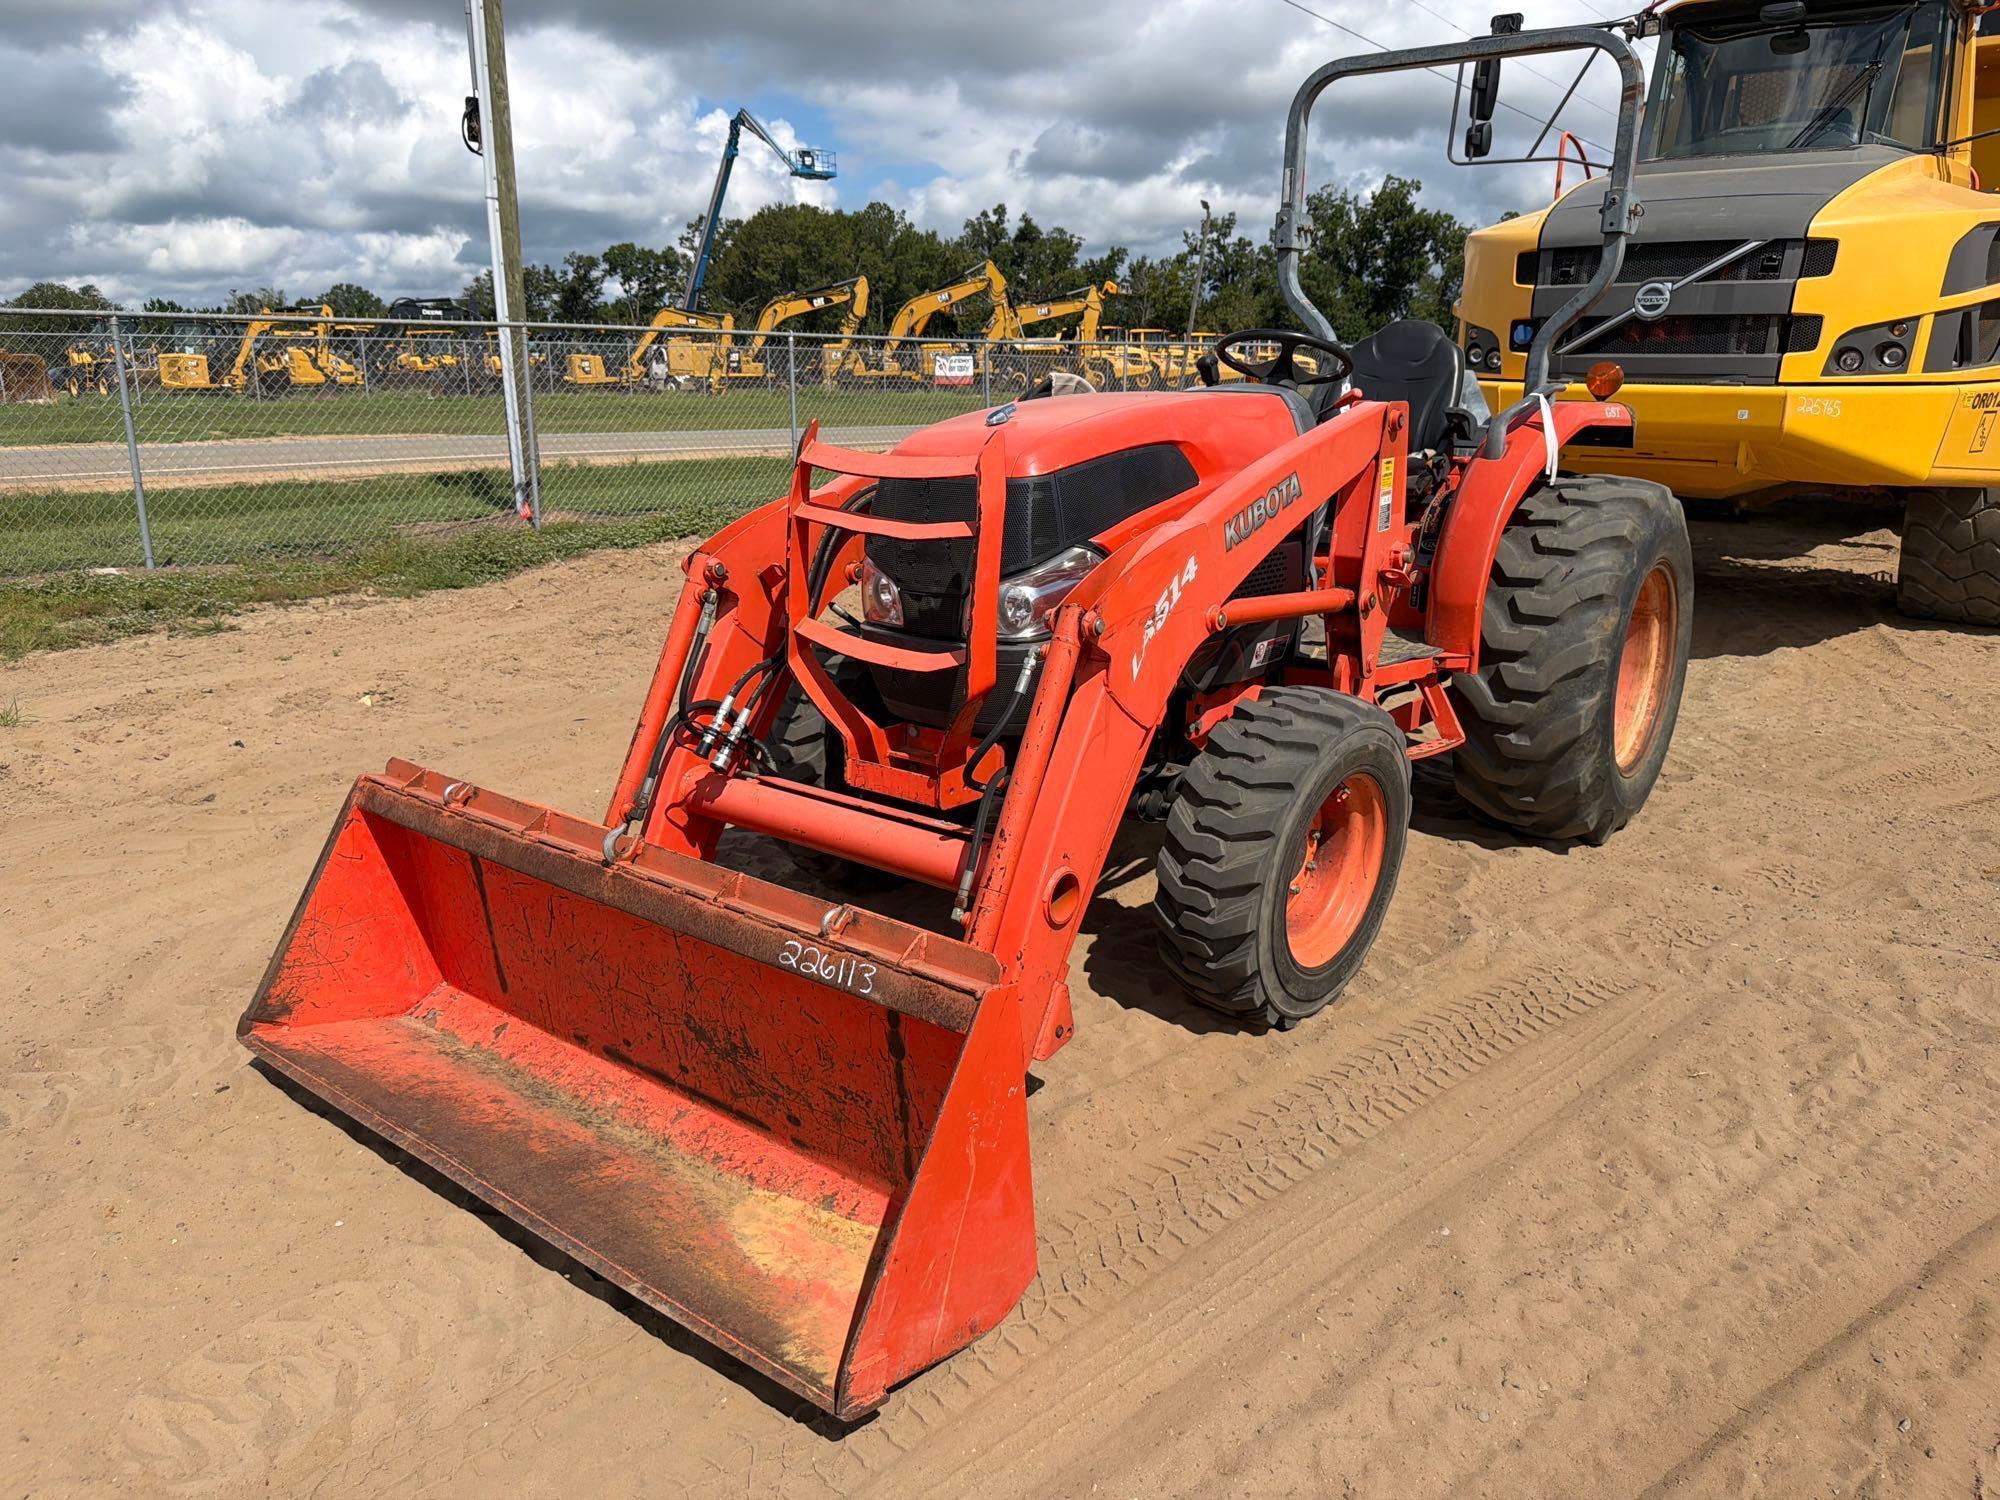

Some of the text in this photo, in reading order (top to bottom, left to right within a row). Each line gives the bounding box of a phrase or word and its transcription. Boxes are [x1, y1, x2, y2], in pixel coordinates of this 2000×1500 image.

[813, 297, 825, 308] CAT
[938, 292, 950, 303] CAT
[421, 308, 443, 316] DEERE
[1037, 306, 1050, 316] CAT
[1604, 406, 1621, 418] GST
[1223, 471, 1303, 553] KUBOTA
[778, 940, 877, 994] 226113
